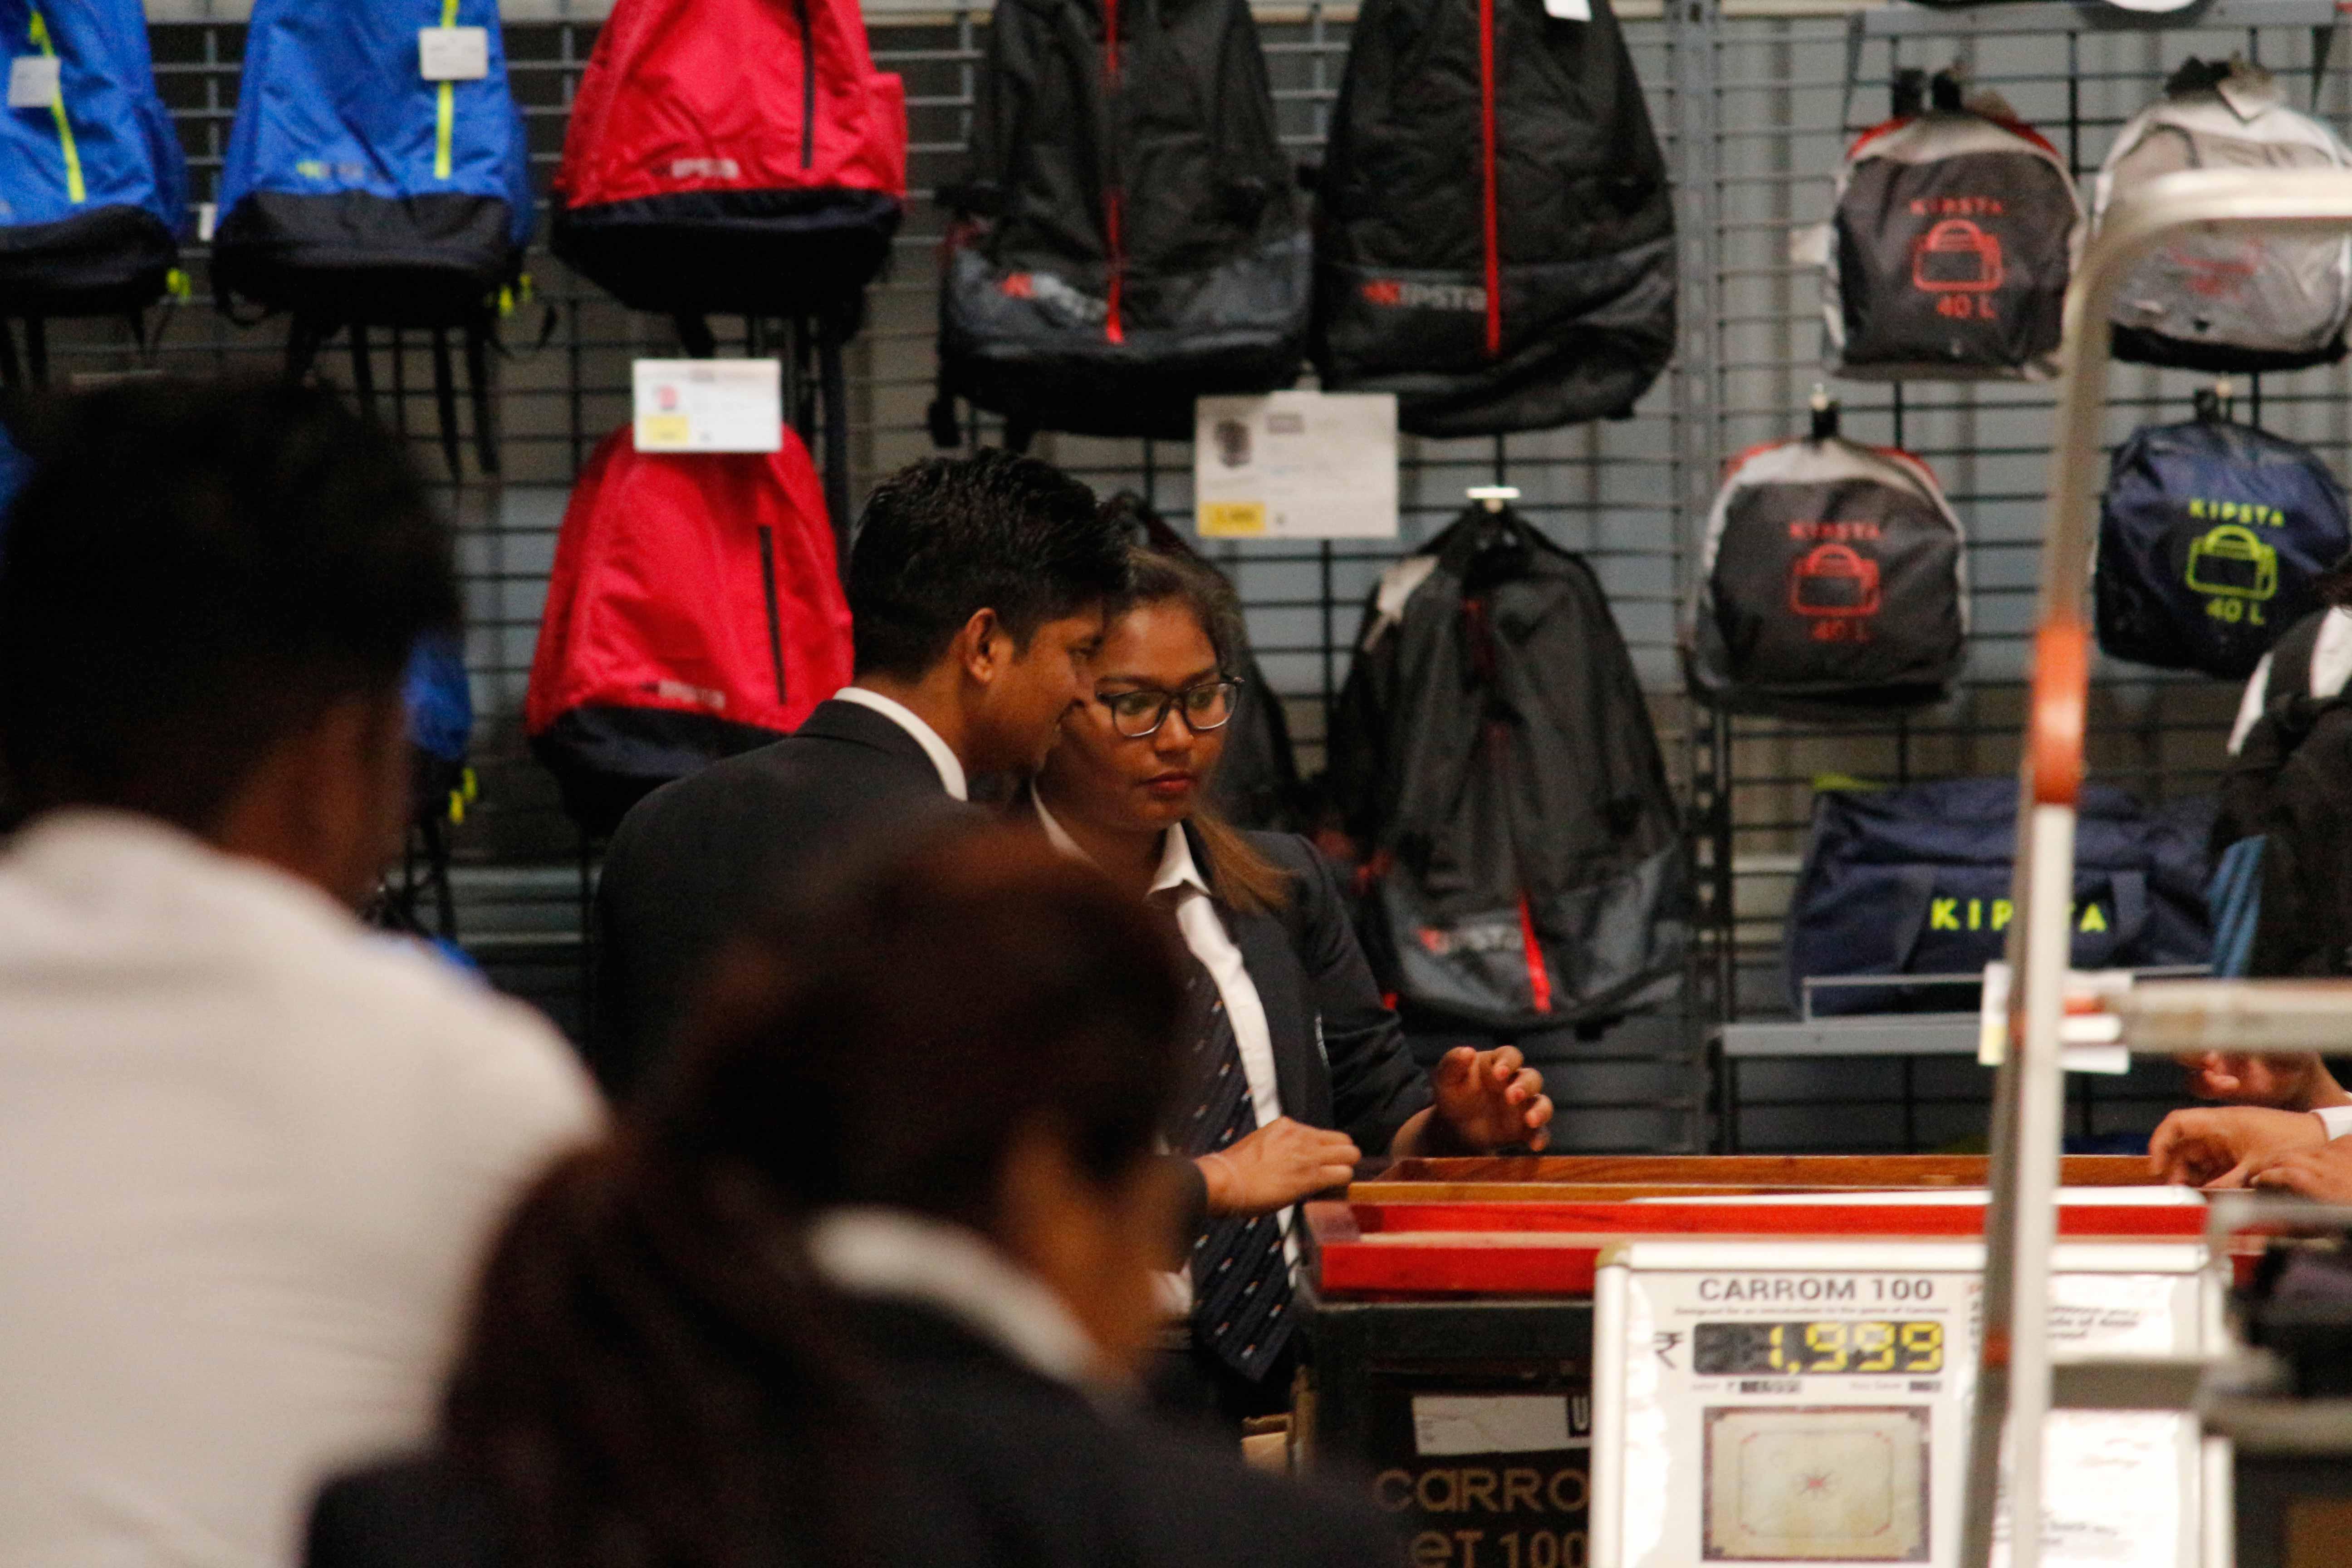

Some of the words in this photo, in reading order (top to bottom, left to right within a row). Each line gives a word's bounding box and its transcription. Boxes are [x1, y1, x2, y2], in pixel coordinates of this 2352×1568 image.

[1930, 897, 2107, 932] KIPA
[1698, 1278, 1857, 1301] CARROM
[1871, 1278, 1934, 1301] 100
[1769, 1321, 1944, 1375] 1,999
